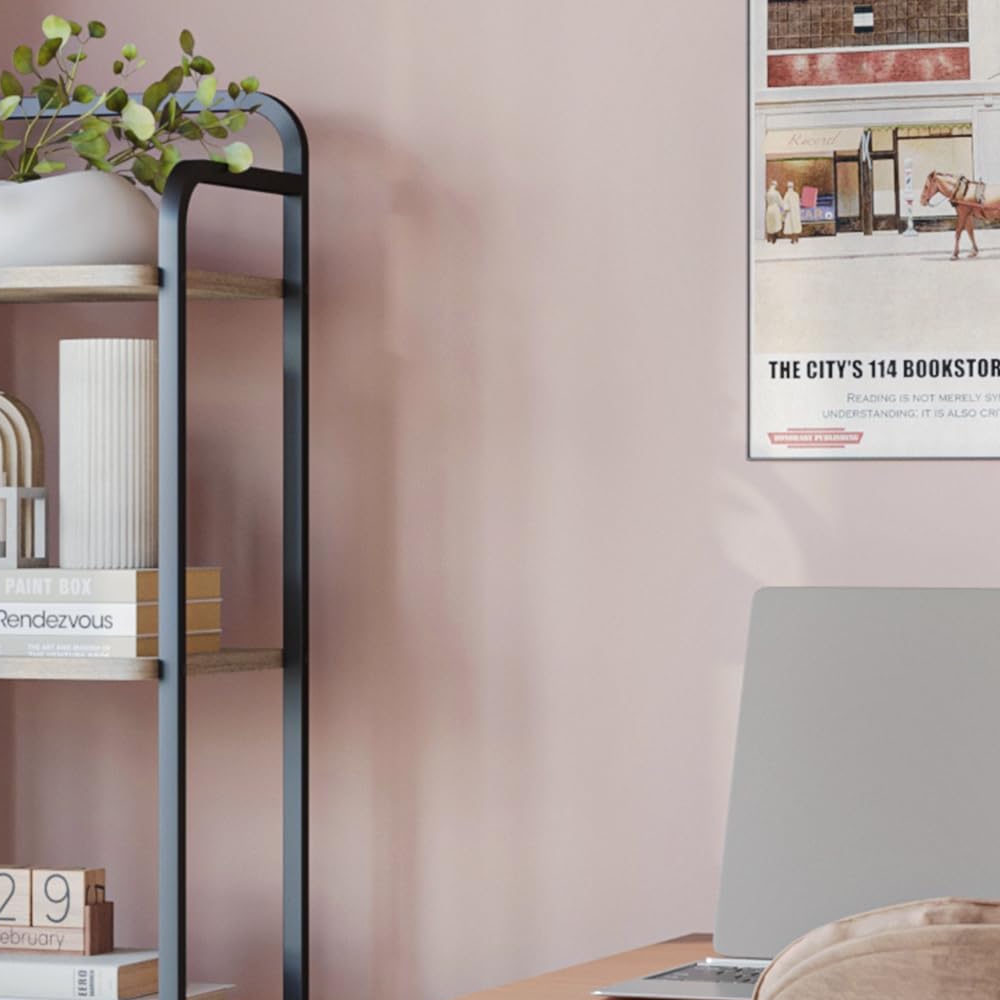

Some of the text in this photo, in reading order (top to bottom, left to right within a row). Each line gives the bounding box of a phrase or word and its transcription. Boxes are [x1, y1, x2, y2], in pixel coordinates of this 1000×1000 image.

[769, 358, 1000, 379] THE CITY'S 114 BOOKSTOR
[912, 393, 935, 402] NOT
[939, 393, 982, 402] MERELY
[921, 408, 931, 417] IT
[947, 408, 977, 418] ALSO
[5, 577, 52, 595] PAINT
[59, 578, 92, 596] BOX
